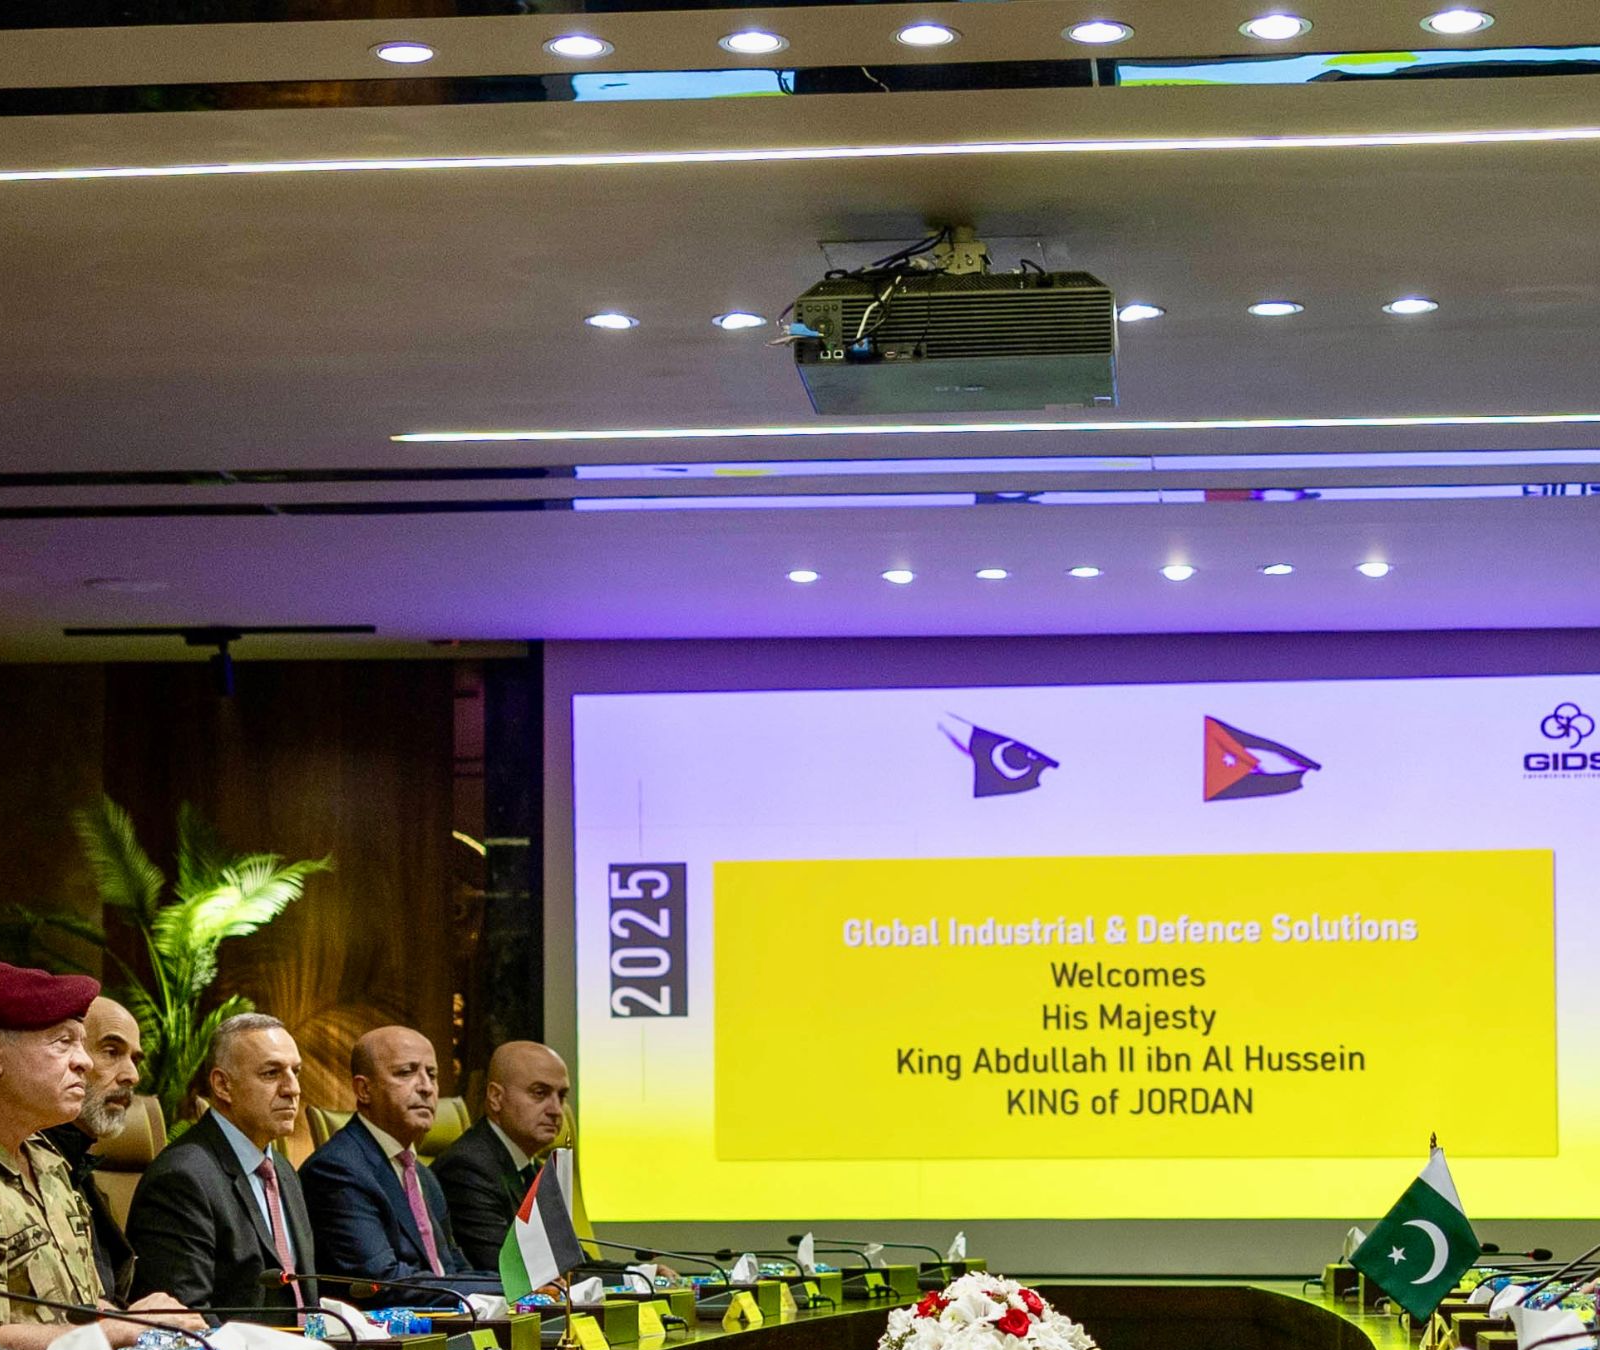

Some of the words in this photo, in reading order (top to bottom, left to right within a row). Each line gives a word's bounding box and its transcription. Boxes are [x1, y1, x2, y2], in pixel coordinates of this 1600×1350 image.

[610, 869, 670, 1016] 2025
[843, 918, 939, 947] Global
[949, 916, 1096, 946] Industrial
[1104, 915, 1127, 944] &
[1137, 914, 1261, 944] Defence
[1272, 912, 1418, 942] Solutions
[1050, 961, 1206, 988] Welcomes
[1042, 1003, 1088, 1030] His
[1099, 1003, 1216, 1036] Majesty
[896, 1048, 962, 1081] King
[973, 1046, 1107, 1074] Abdullah
[1119, 1046, 1134, 1073] II
[1147, 1045, 1191, 1072] ibn
[1203, 1045, 1233, 1072] Al
[1245, 1044, 1365, 1071] Hussein
[1007, 1088, 1079, 1115] KING
[1091, 1088, 1118, 1115] of
[1130, 1087, 1253, 1114] JORDAN
